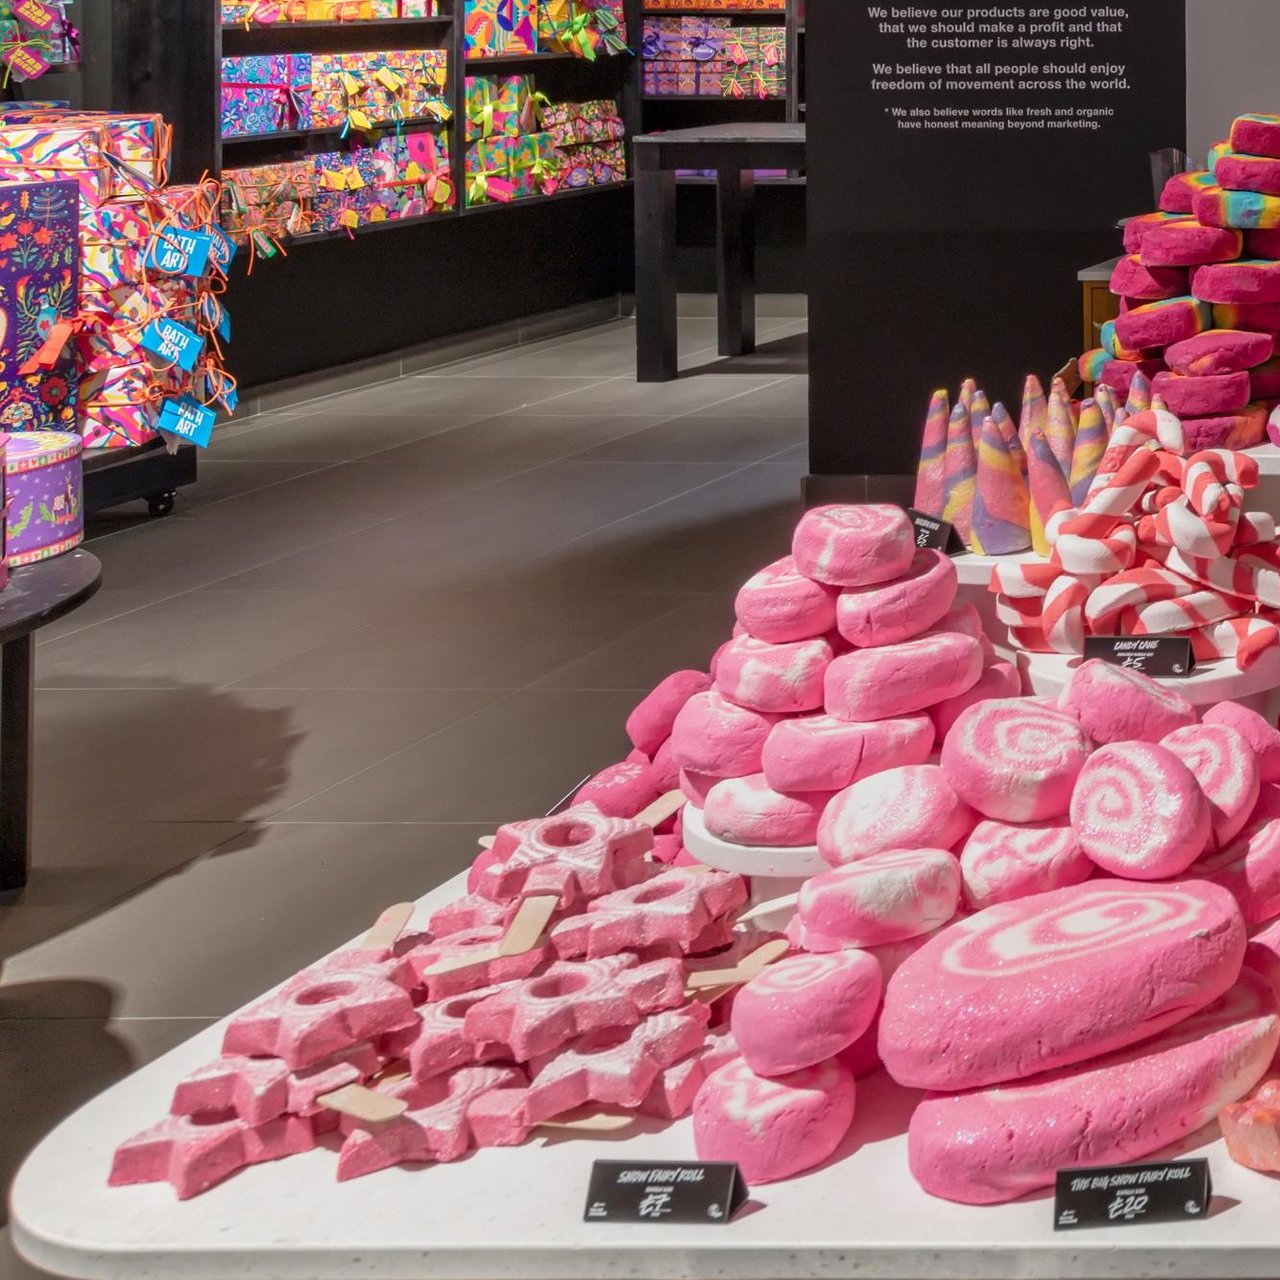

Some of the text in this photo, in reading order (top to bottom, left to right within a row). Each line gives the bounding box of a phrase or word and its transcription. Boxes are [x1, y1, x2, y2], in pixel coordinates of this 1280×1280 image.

[872, 62, 1126, 77] We believe that all people should enjoy
[870, 78, 1131, 90] freedom of movement across the world.
[891, 107, 908, 117] We
[909, 107, 931, 117] also
[933, 107, 970, 117] believe
[971, 107, 1004, 117] words
[1005, 107, 1024, 116] like
[1026, 107, 1052, 116] fresh
[1054, 107, 1074, 116] and
[1076, 107, 1114, 118] organic
[897, 119, 1101, 131] have honest meaning beyond marketing.
[162, 324, 189, 350] BATH
[177, 401, 204, 426] BATH
[175, 417, 198, 437] ART
[1113, 639, 1161, 651] CANDY CANE
[616, 1167, 705, 1184] SNOW FAIRY ROLL
[1071, 1167, 1191, 1192] THE BIG SNOW FAIRY ROLL
